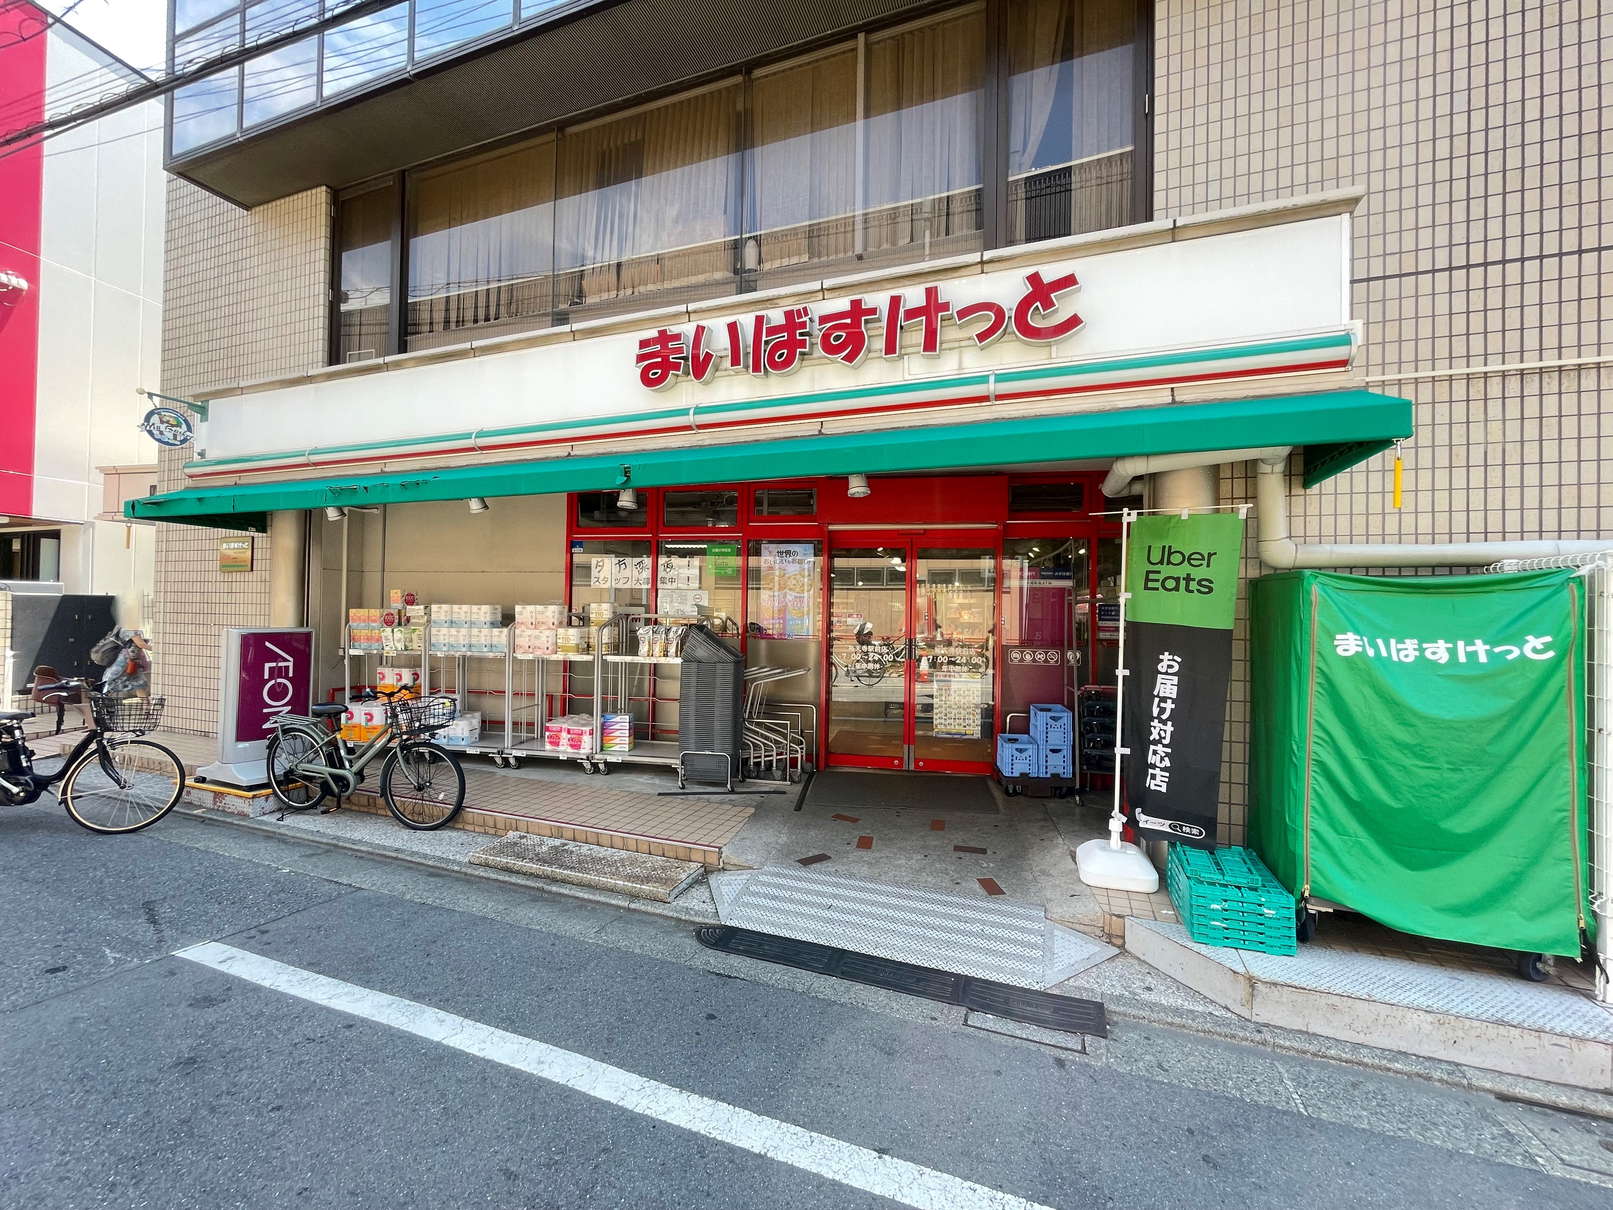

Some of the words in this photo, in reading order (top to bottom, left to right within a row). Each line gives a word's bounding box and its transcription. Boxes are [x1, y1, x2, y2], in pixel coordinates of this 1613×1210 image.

[635, 271, 1087, 391] まいばすけっと
[1146, 545, 1217, 568] Uber
[1143, 570, 1214, 595] Eats
[1334, 632, 1556, 664] まいばすけっと
[1145, 651, 1182, 793] お届け対応店
